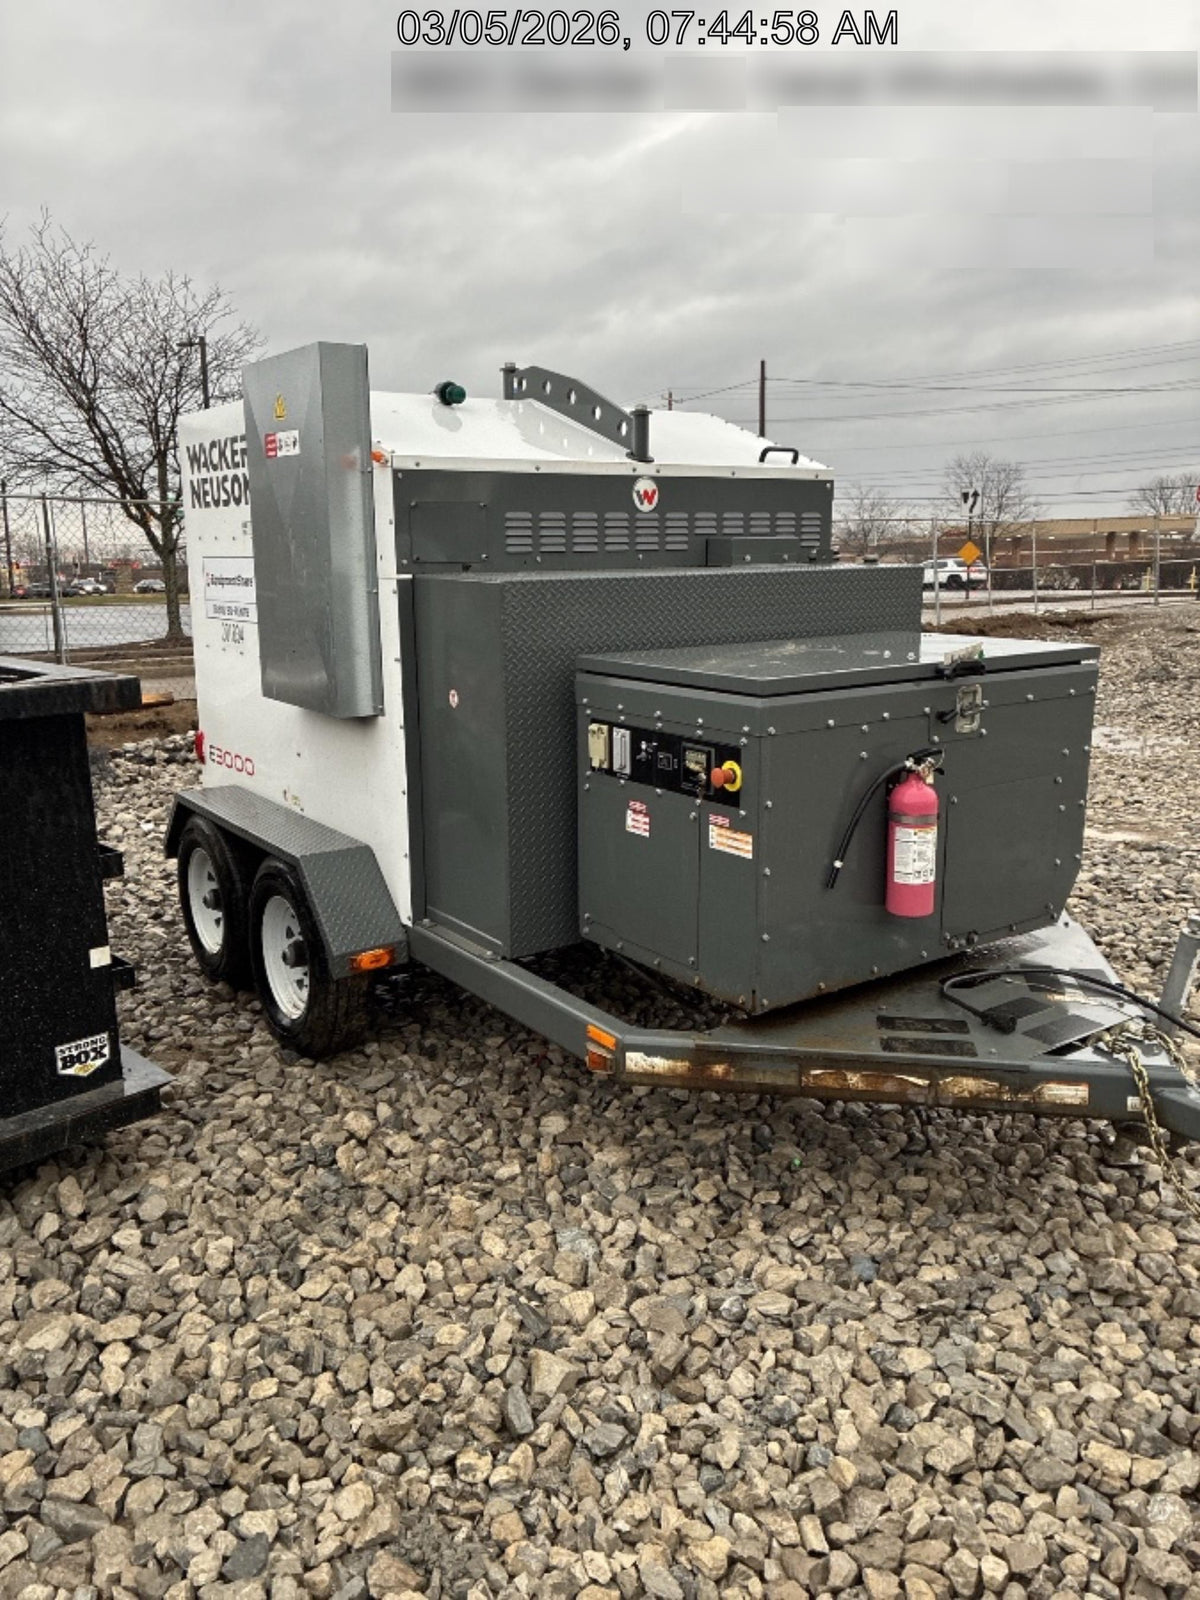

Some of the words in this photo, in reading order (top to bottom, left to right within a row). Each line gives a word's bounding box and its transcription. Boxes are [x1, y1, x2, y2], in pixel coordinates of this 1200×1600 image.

[190, 473, 250, 509] NEUSON
[208, 744, 256, 777] E3000
[58, 1036, 106, 1056] STRONG
[60, 1043, 107, 1070] BOX
